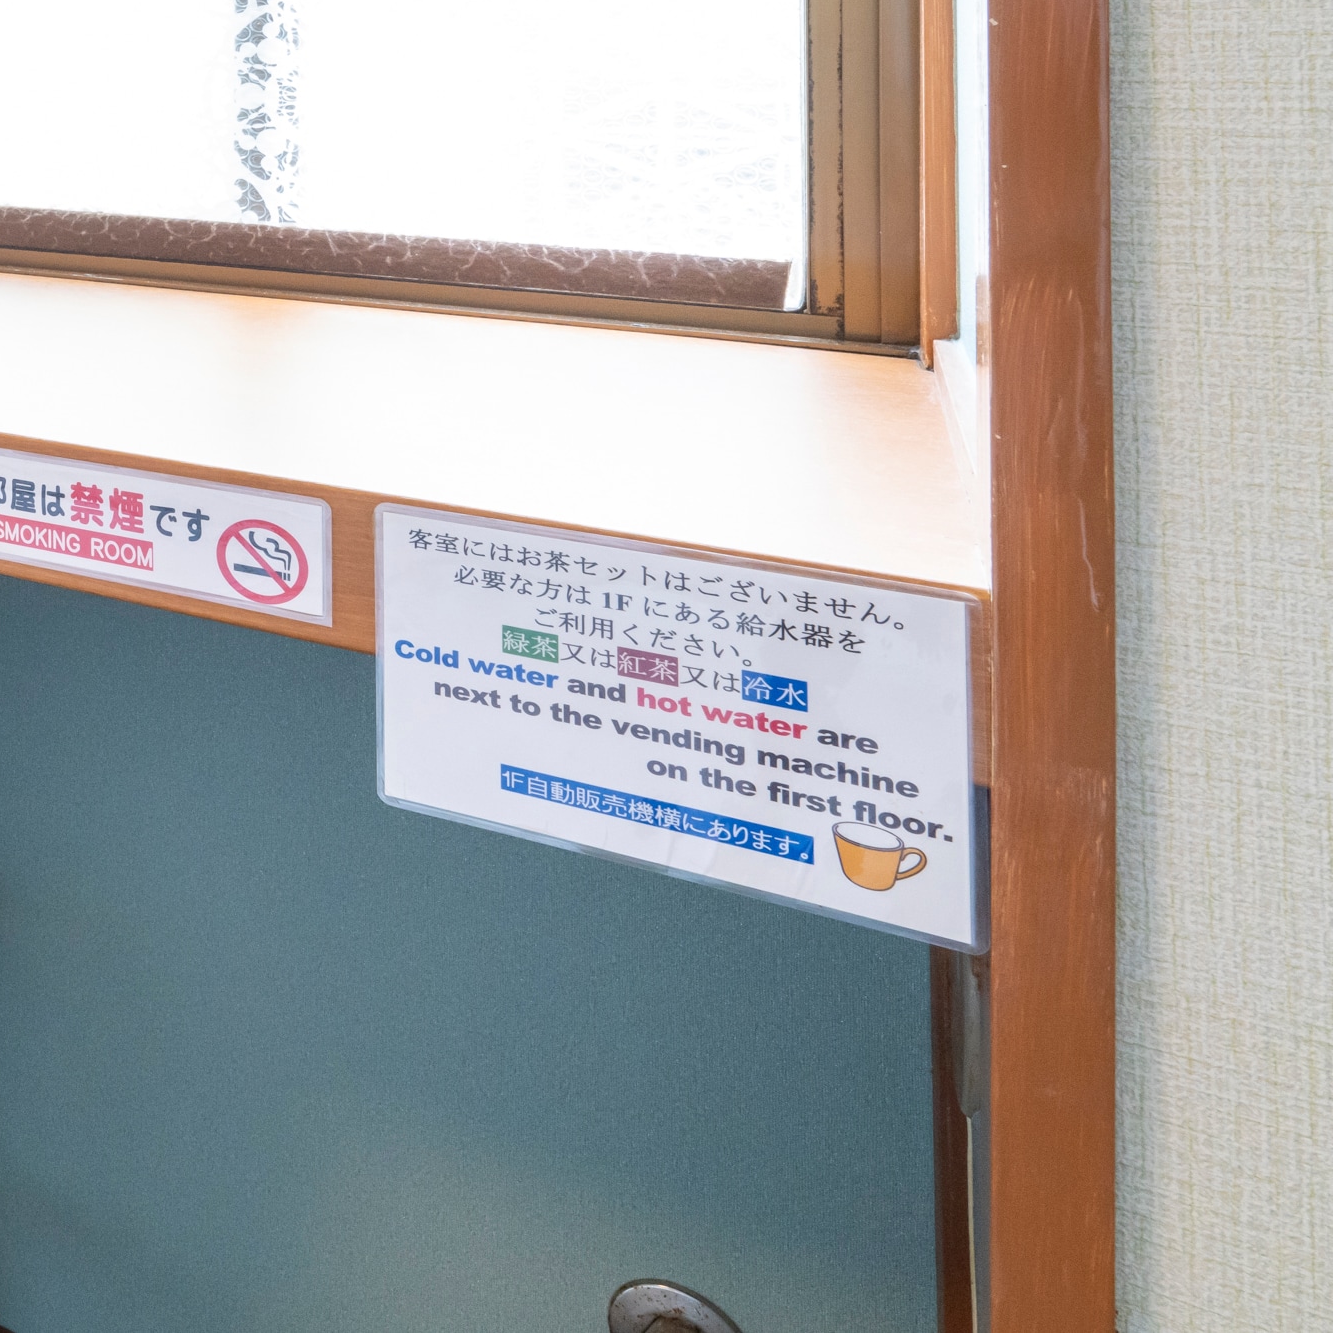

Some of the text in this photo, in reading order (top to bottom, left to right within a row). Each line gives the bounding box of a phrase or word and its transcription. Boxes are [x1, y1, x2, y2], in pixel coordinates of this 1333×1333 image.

[90, 537, 153, 569] ROOM
[408, 528, 905, 631] 客室にはお茶セットはございません。
[533, 607, 753, 667] ご利用ください。
[394, 639, 879, 755] Cold water and hot water are
[434, 680, 921, 798] next to the vending machine
[501, 769, 810, 861] 1F自動販売機横にあります。
[646, 759, 954, 843] on the first floor.
